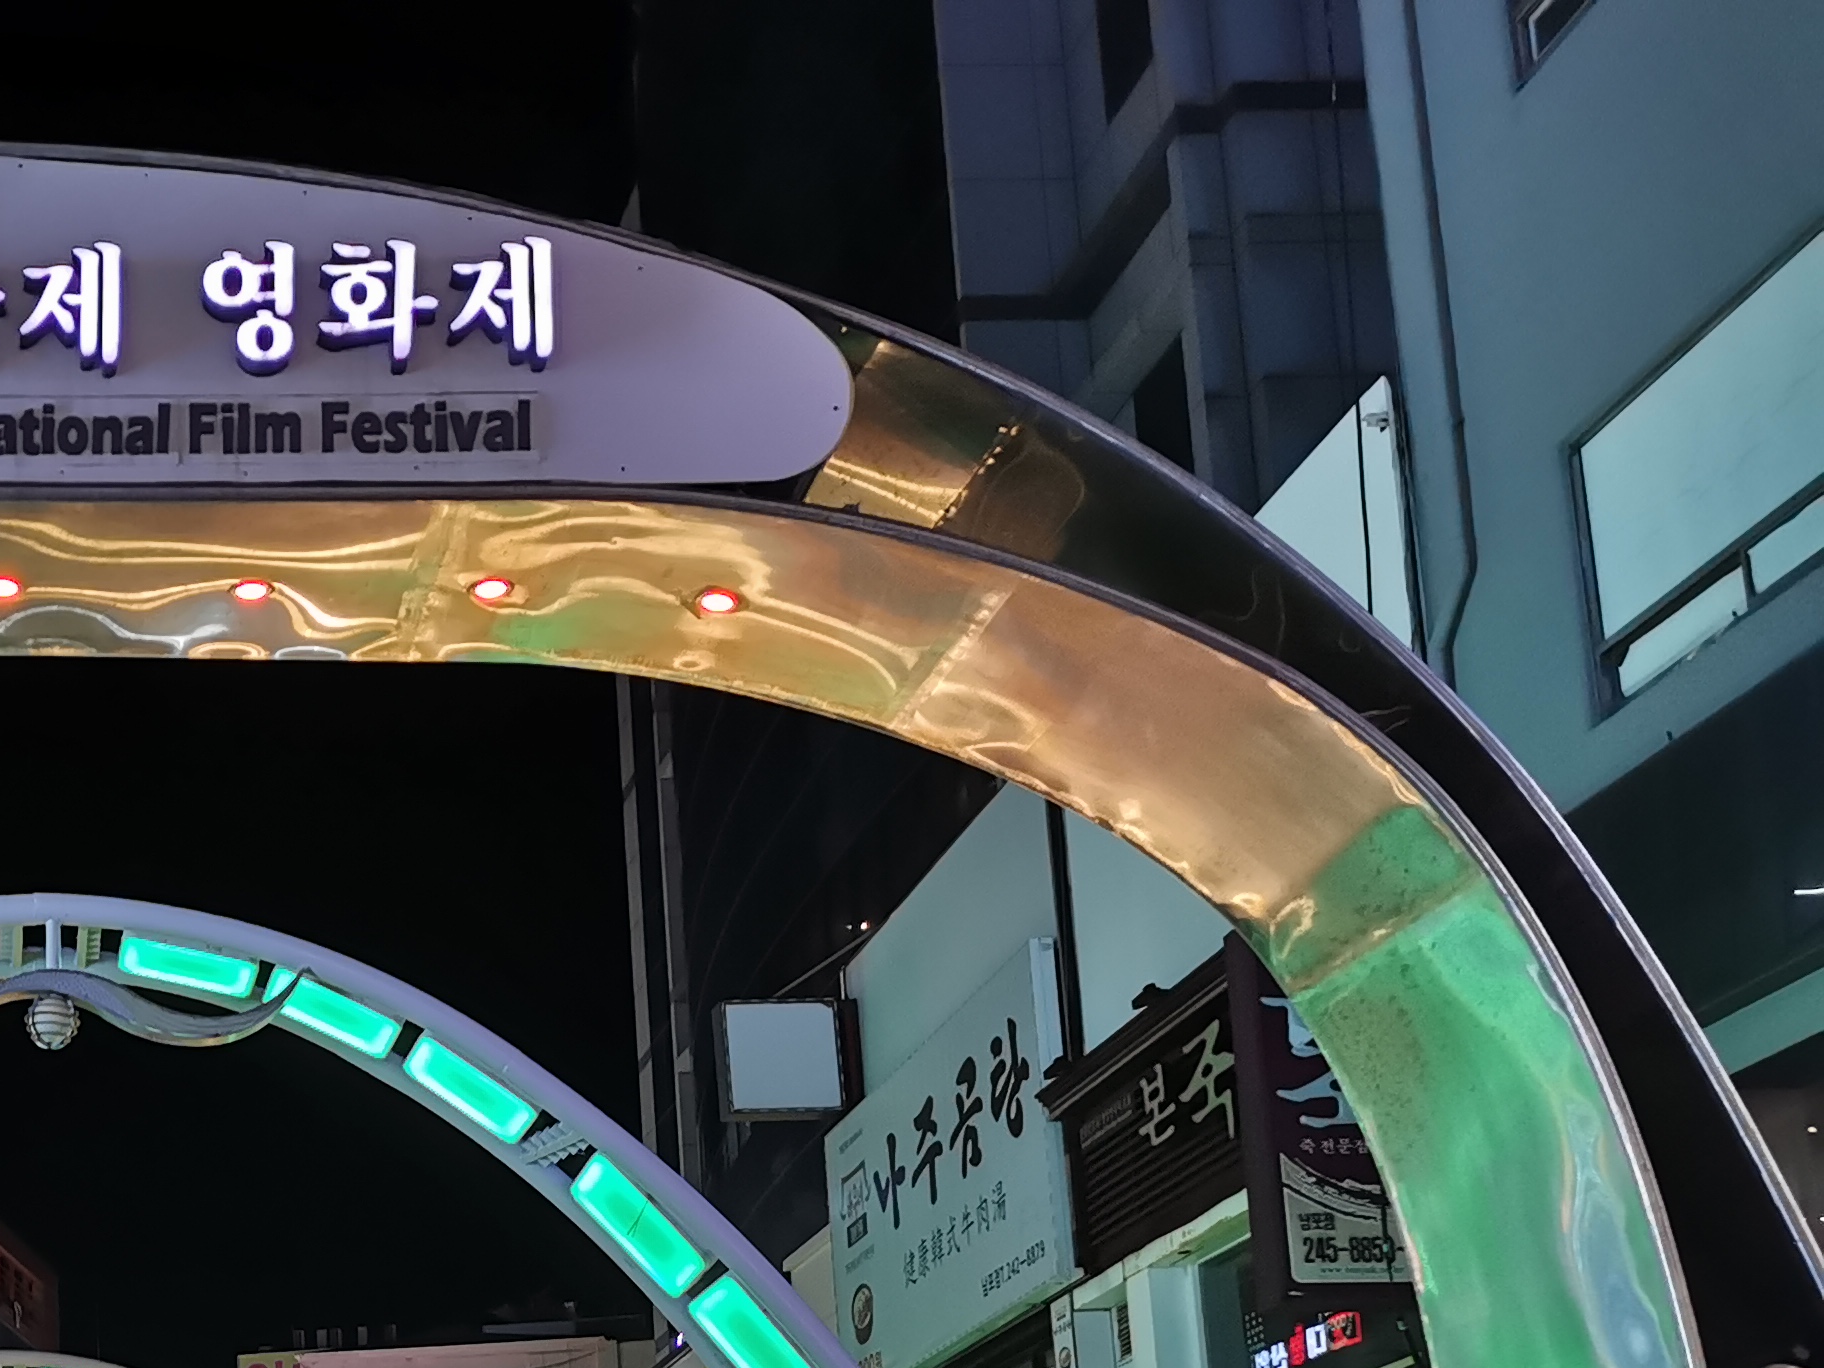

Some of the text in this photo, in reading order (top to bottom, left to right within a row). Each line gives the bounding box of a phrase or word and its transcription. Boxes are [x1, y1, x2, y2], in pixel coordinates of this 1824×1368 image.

[202, 237, 554, 376] 영화제
[188, 402, 302, 454] Film
[321, 399, 531, 453] Festival
[873, 1017, 1029, 1230] 나주곰탕
[1138, 1019, 1236, 1147] 본죽
